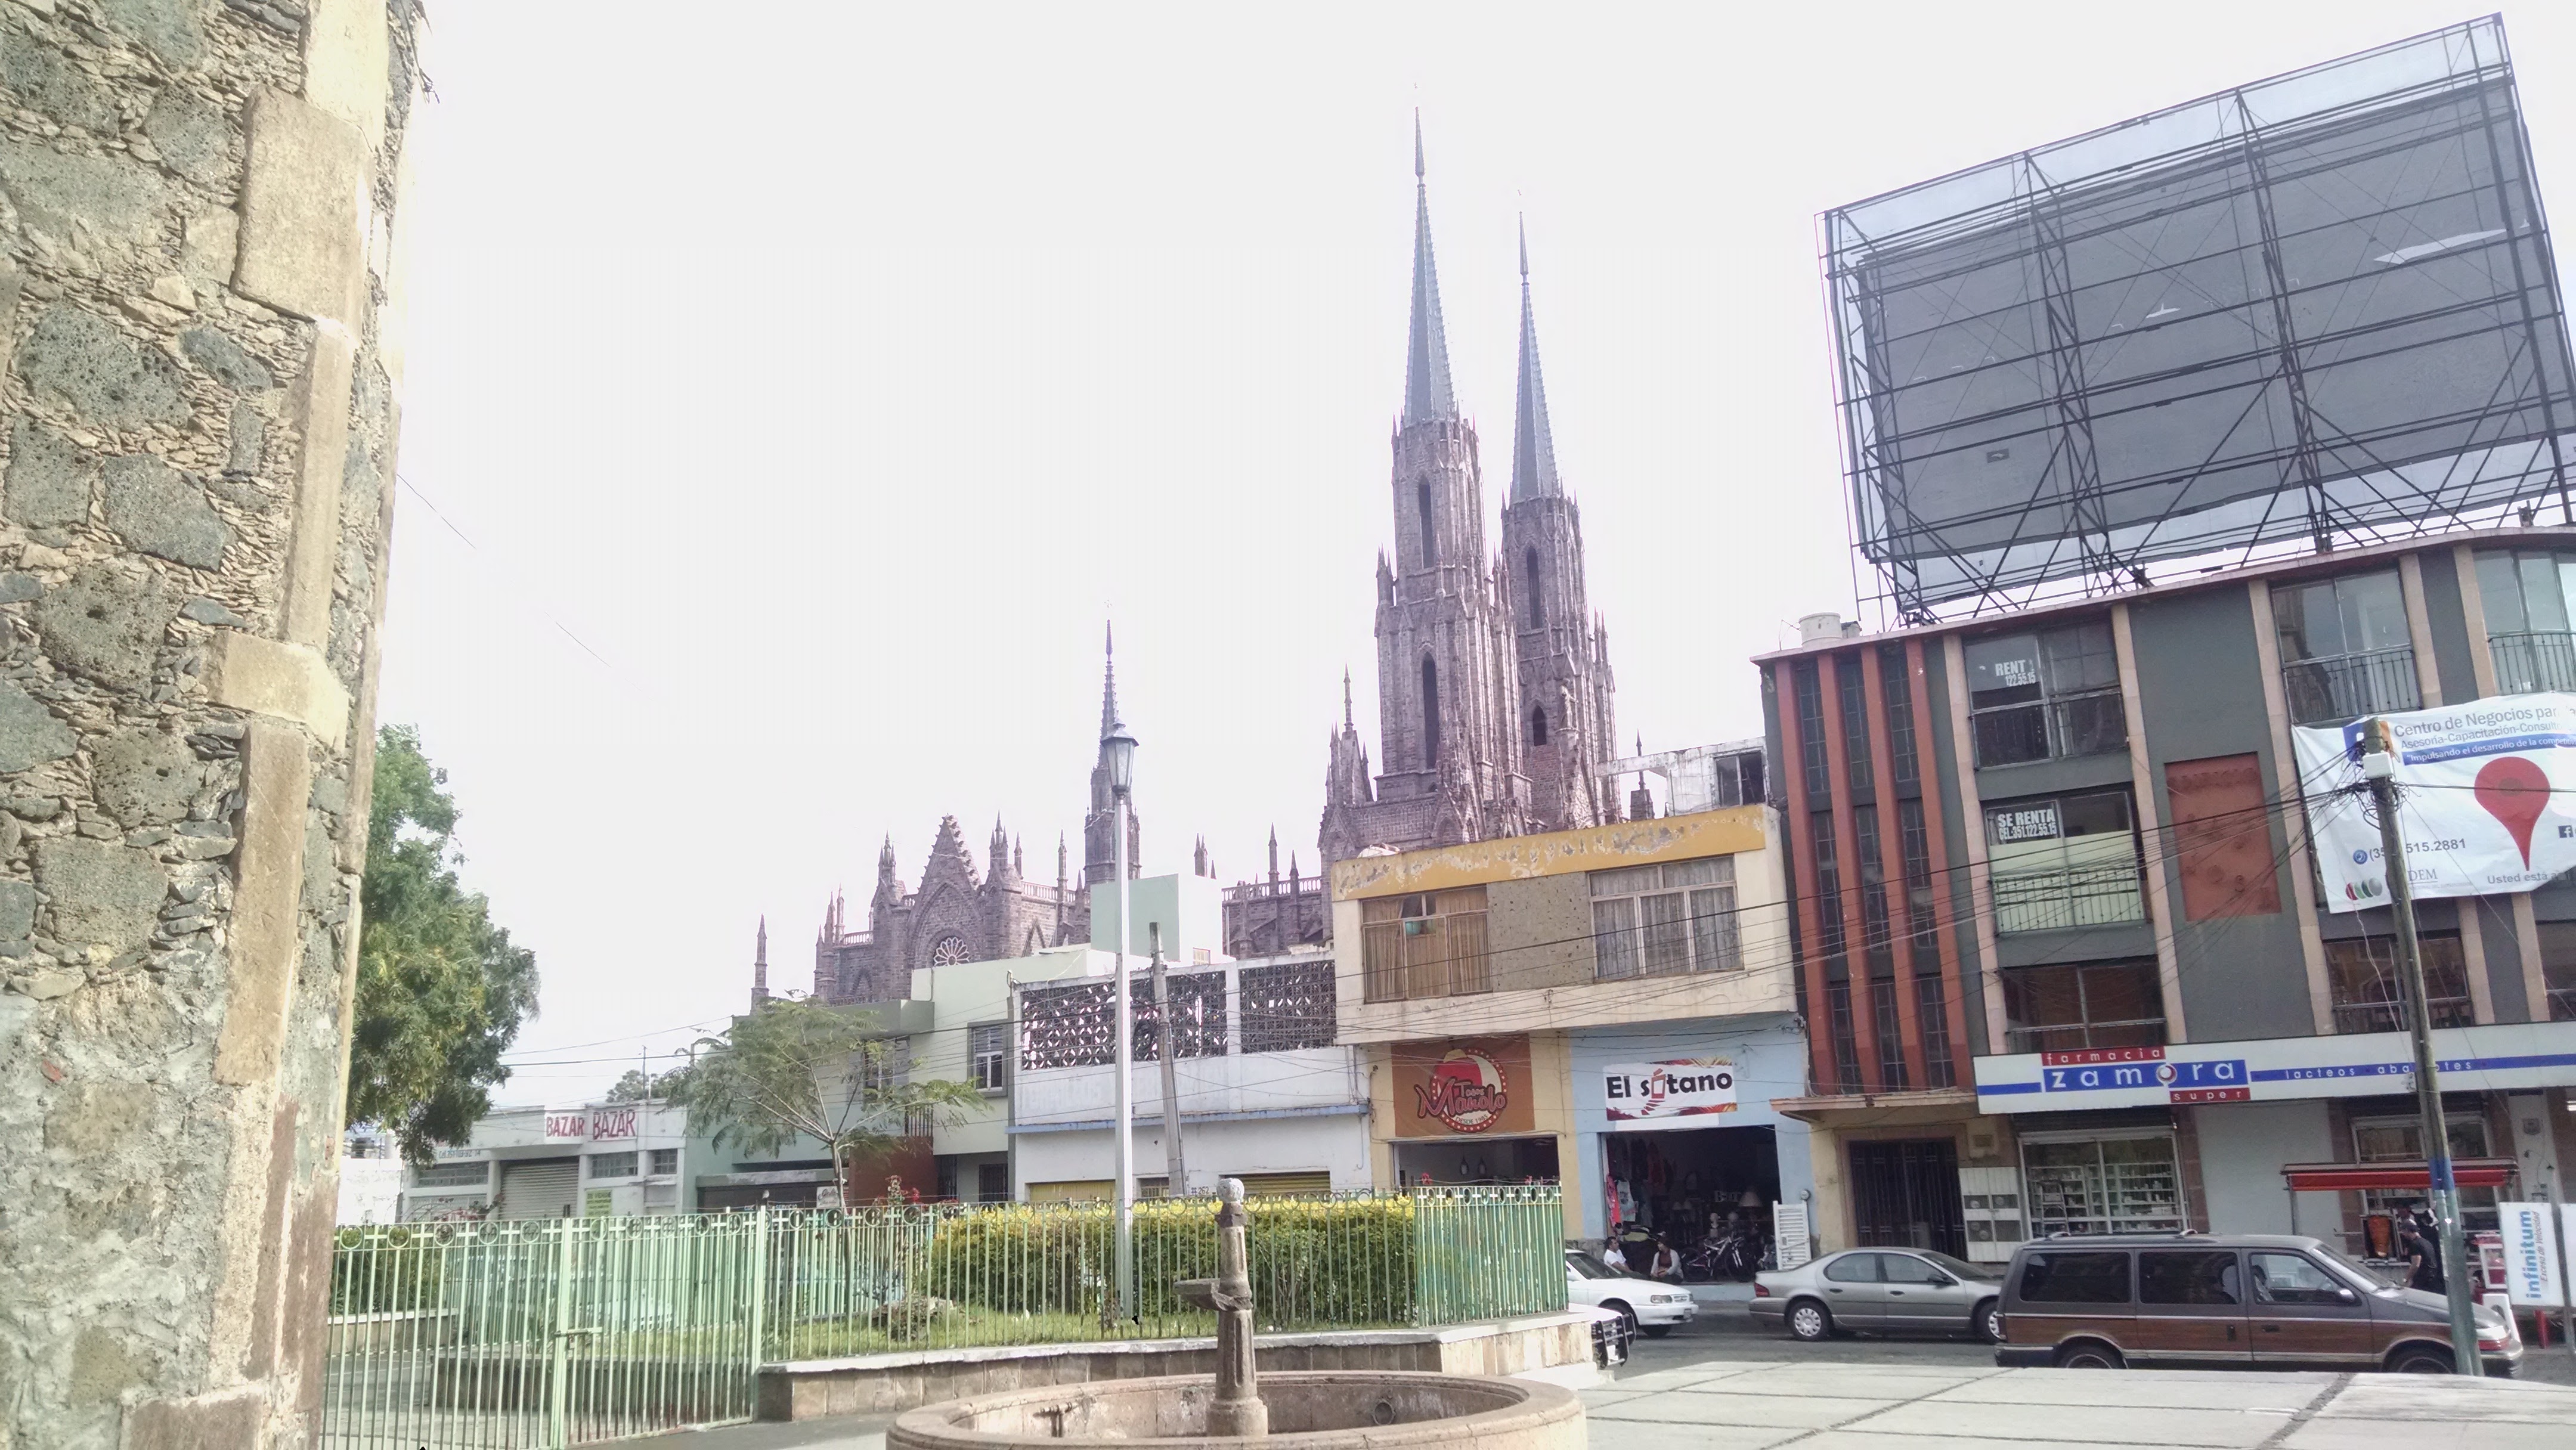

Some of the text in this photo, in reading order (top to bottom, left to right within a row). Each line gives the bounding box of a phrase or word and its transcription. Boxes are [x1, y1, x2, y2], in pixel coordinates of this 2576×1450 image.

[1995, 658, 2034, 676] RENT
[2394, 720, 2441, 738] Centro
[2445, 716, 2463, 730] de
[2466, 707, 2532, 727] Negocios
[2535, 708, 2559, 720] par
[2472, 741, 2515, 754] desarrollo
[1998, 808, 2056, 828] SE RENTA
[2406, 838, 2466, 854] 515.2881
[2487, 873, 2521, 884] Usted
[2524, 872, 2547, 881] está
[2047, 1046, 2160, 1066] farmacia
[2052, 1061, 2235, 1089] zamora
[2285, 1061, 2472, 1079] lacteos abaotes
[1606, 1075, 1631, 1099] El
[2174, 1090, 2242, 1101] super
[1414, 1076, 1507, 1119] Manolo
[546, 1116, 585, 1137] BAZAR
[593, 1108, 636, 1141] BAZAR
[1455, 1116, 1473, 1125] DESDE
[2519, 1210, 2541, 1299] infinitum
[2532, 1211, 2548, 1282] Exceso de Velocidad
